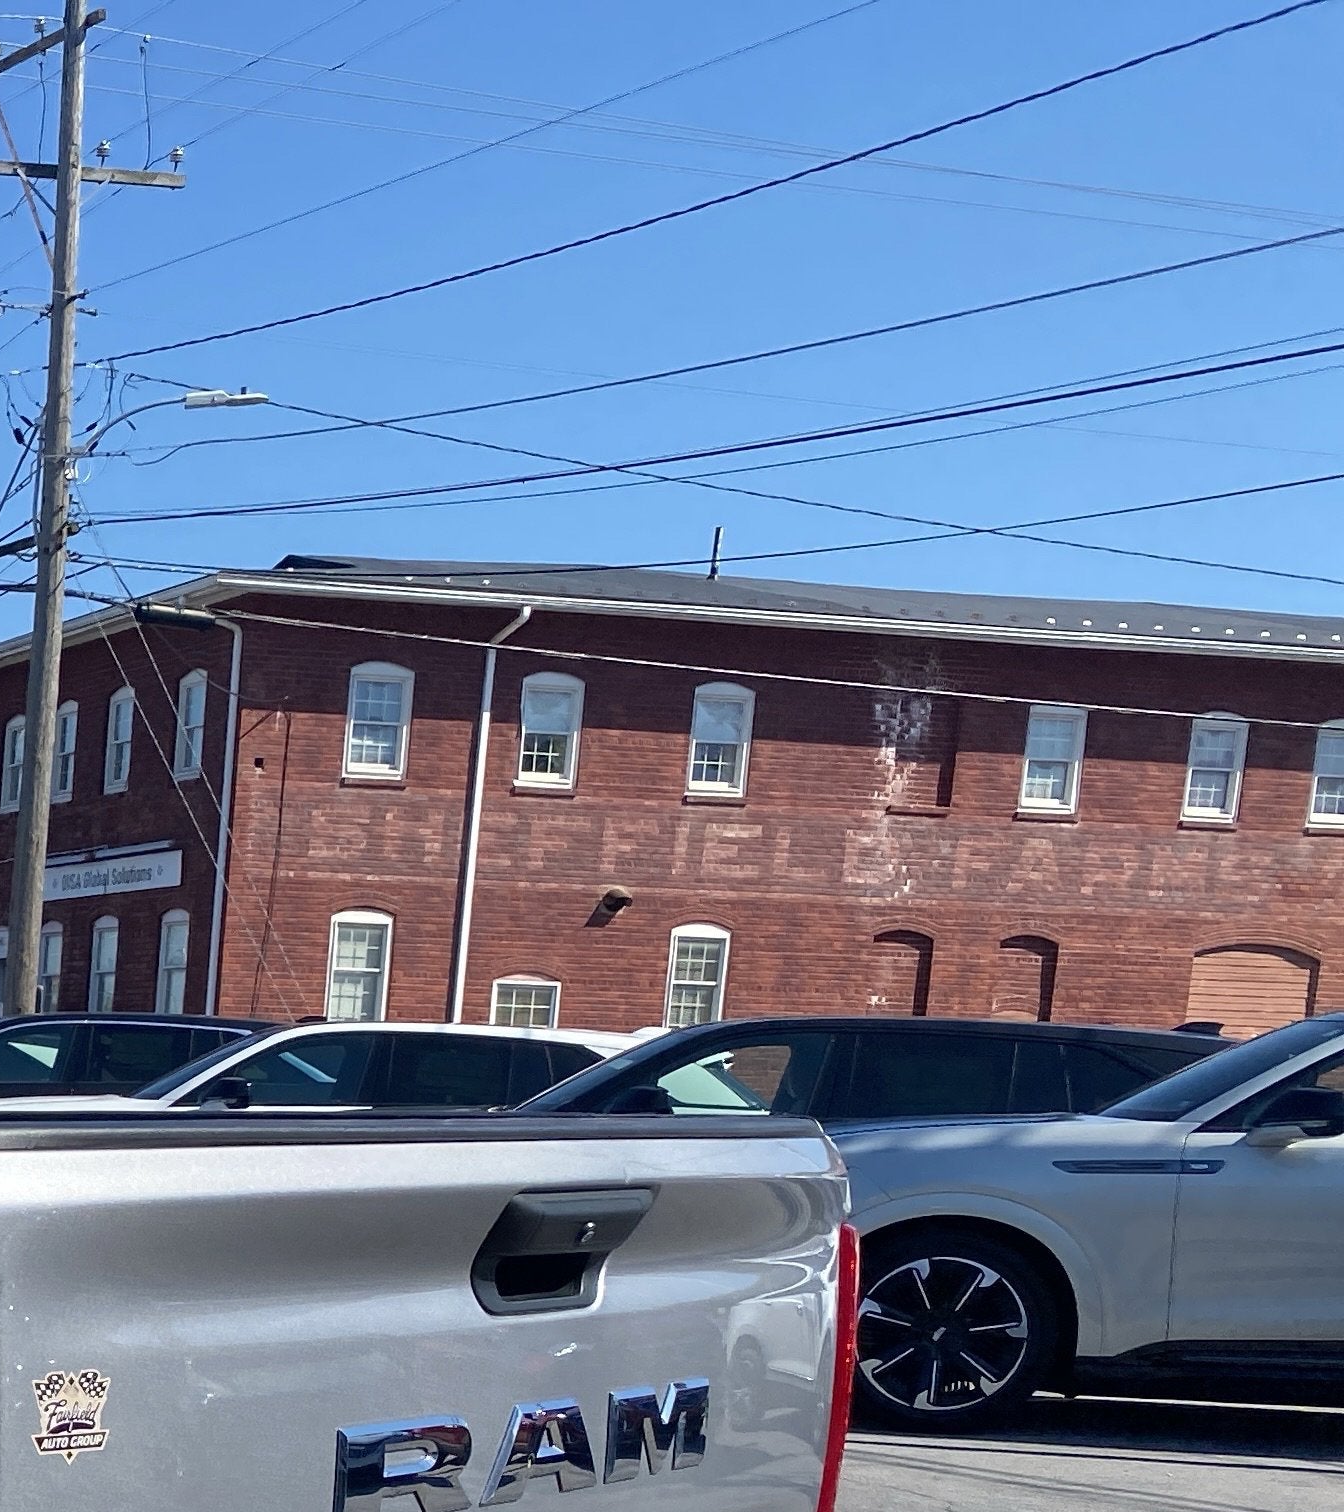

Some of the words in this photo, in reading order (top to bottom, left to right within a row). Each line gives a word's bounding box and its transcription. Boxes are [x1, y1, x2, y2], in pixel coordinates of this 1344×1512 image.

[83, 868, 110, 889] Global
[112, 866, 153, 885] Solutions
[40, 1436, 69, 1450] AUTO
[70, 1434, 104, 1448] GROUP
